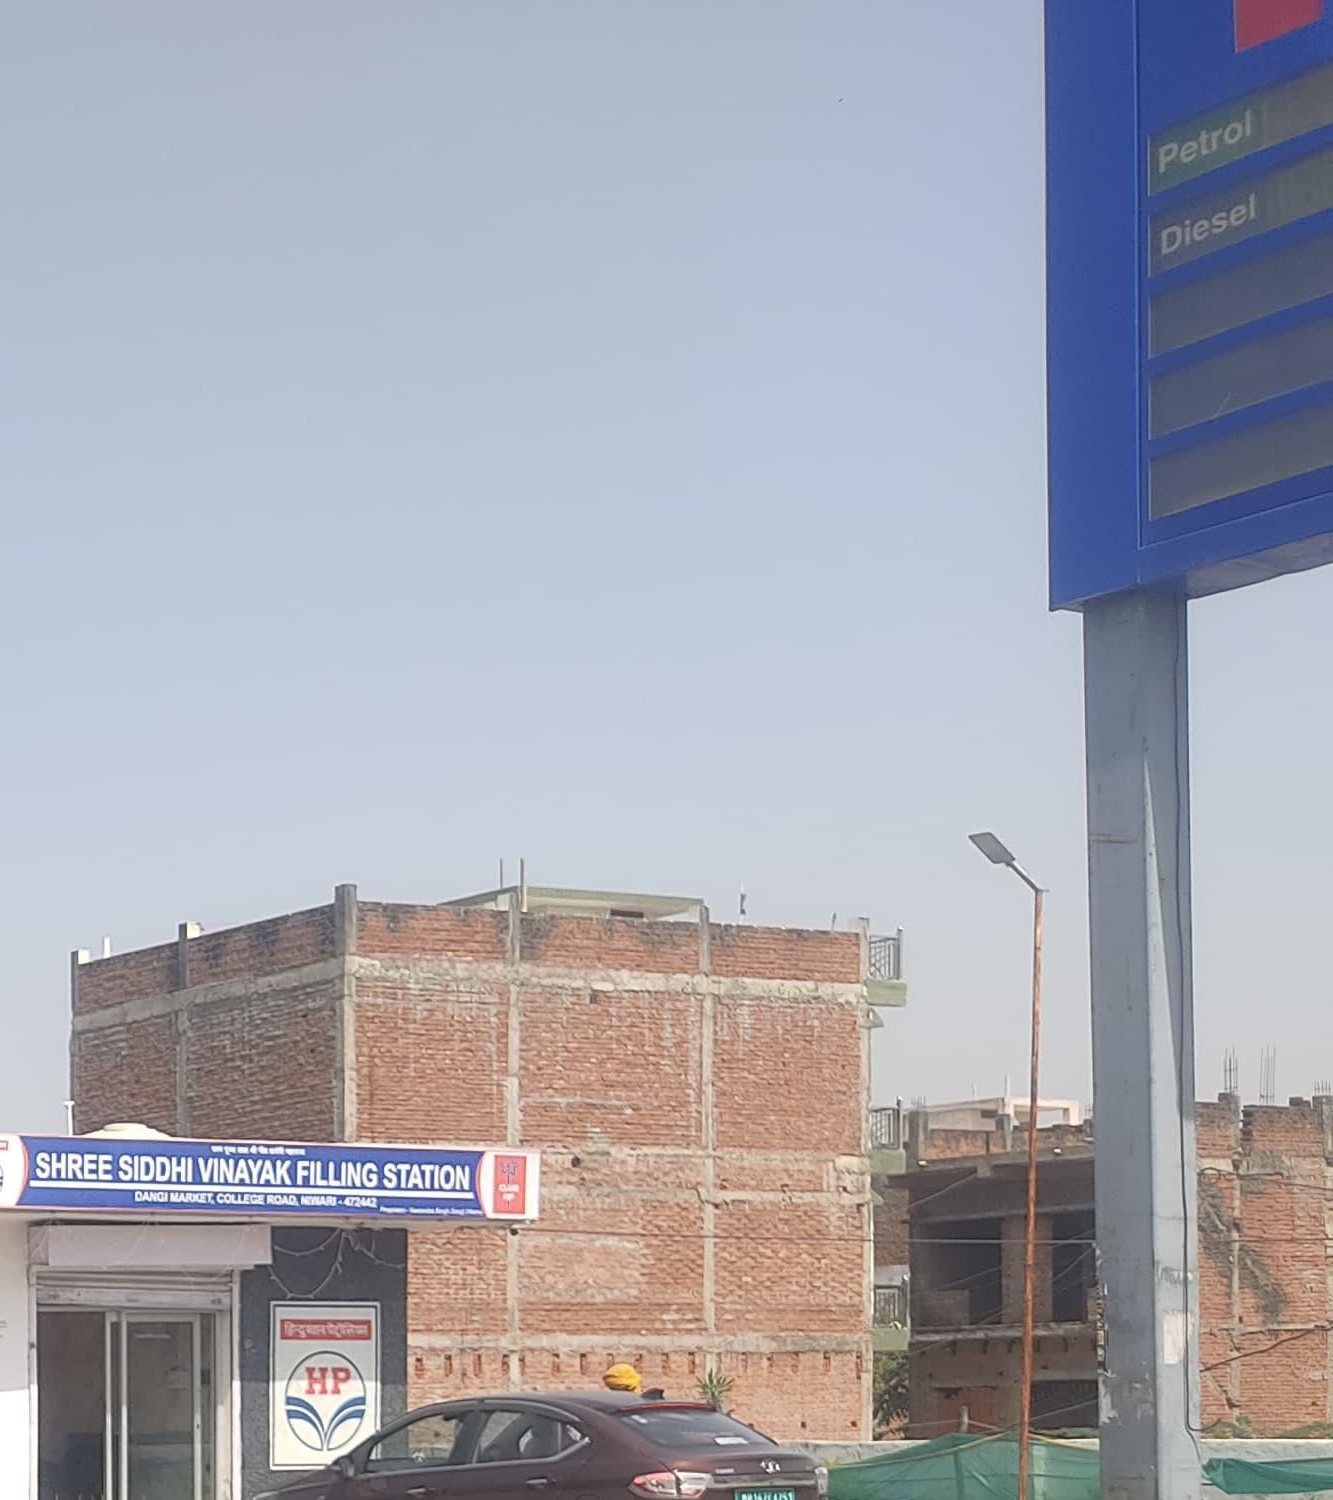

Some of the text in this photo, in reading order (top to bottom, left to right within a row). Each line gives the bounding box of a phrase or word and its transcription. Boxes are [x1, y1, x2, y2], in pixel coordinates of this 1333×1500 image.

[1158, 109, 1253, 174] Petrol
[1160, 193, 1256, 256] Diesel
[35, 1152, 470, 1190] SHREE SIDDHI VINAYAK FILLING STATION
[134, 1191, 168, 1203] DANGI
[170, 1192, 215, 1204] MARKET,
[216, 1193, 265, 1205] COLLEGE
[267, 1194, 299, 1206] ROAD,
[305, 1366, 351, 1395] HP
